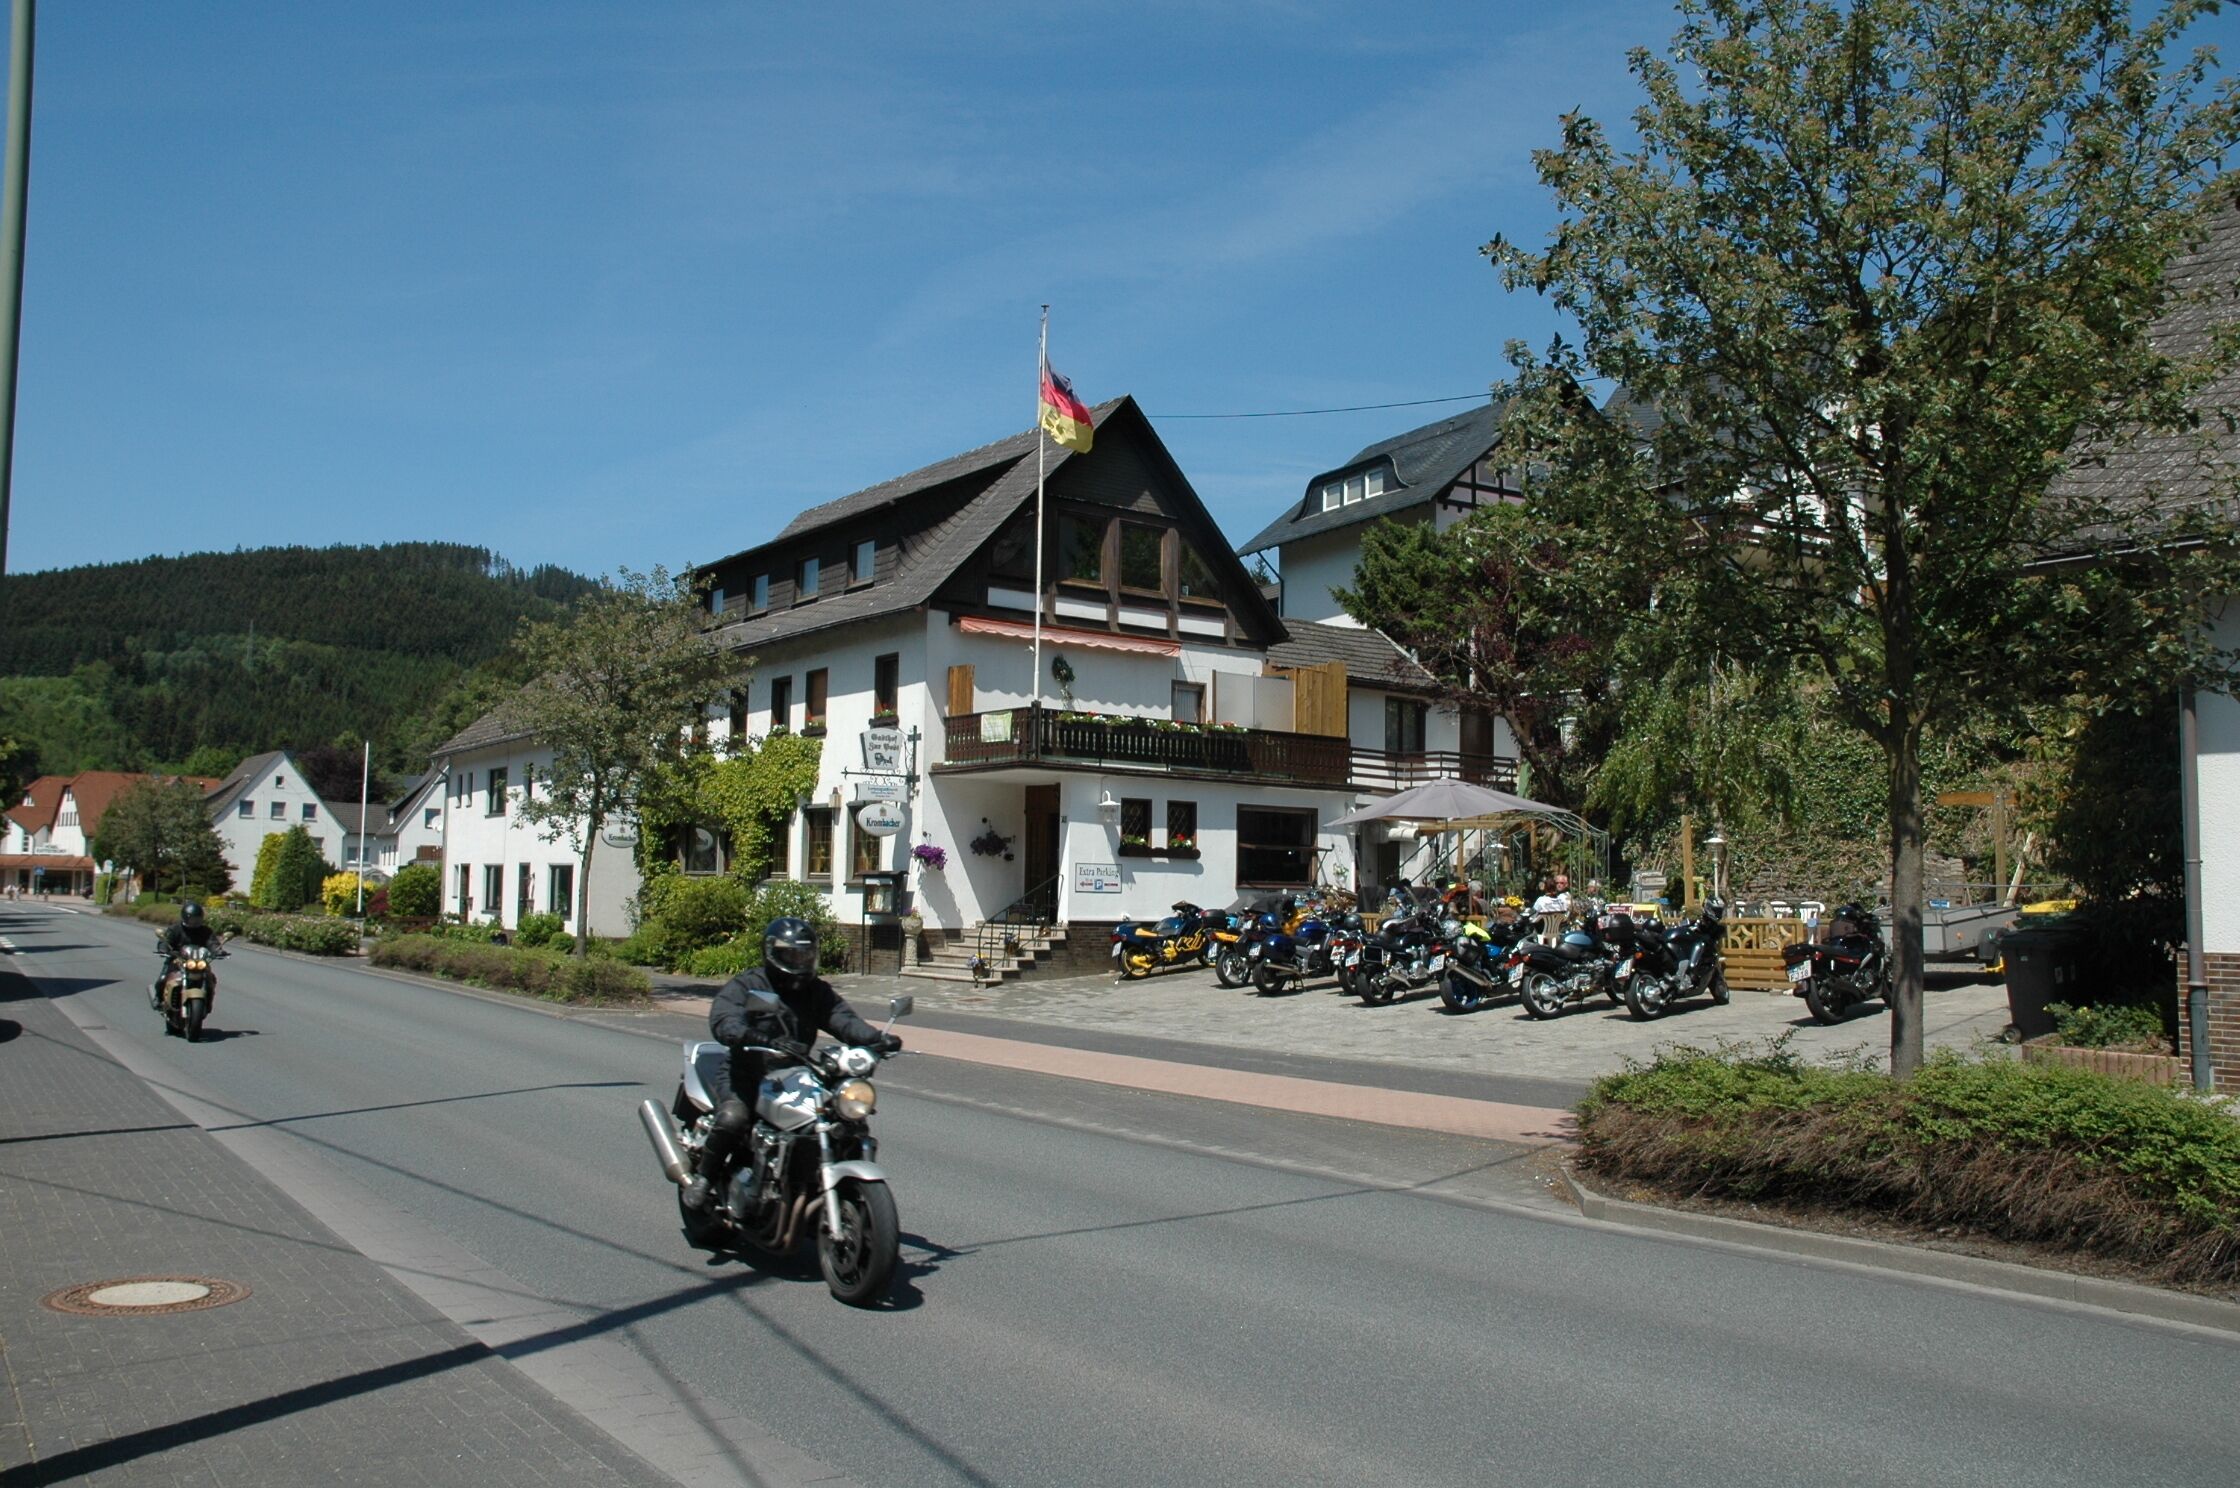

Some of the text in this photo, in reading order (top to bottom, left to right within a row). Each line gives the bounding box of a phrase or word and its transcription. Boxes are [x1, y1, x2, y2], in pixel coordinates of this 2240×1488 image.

[866, 817, 901, 827] Krombacher
[1079, 867, 1120, 878] Extra Parking
